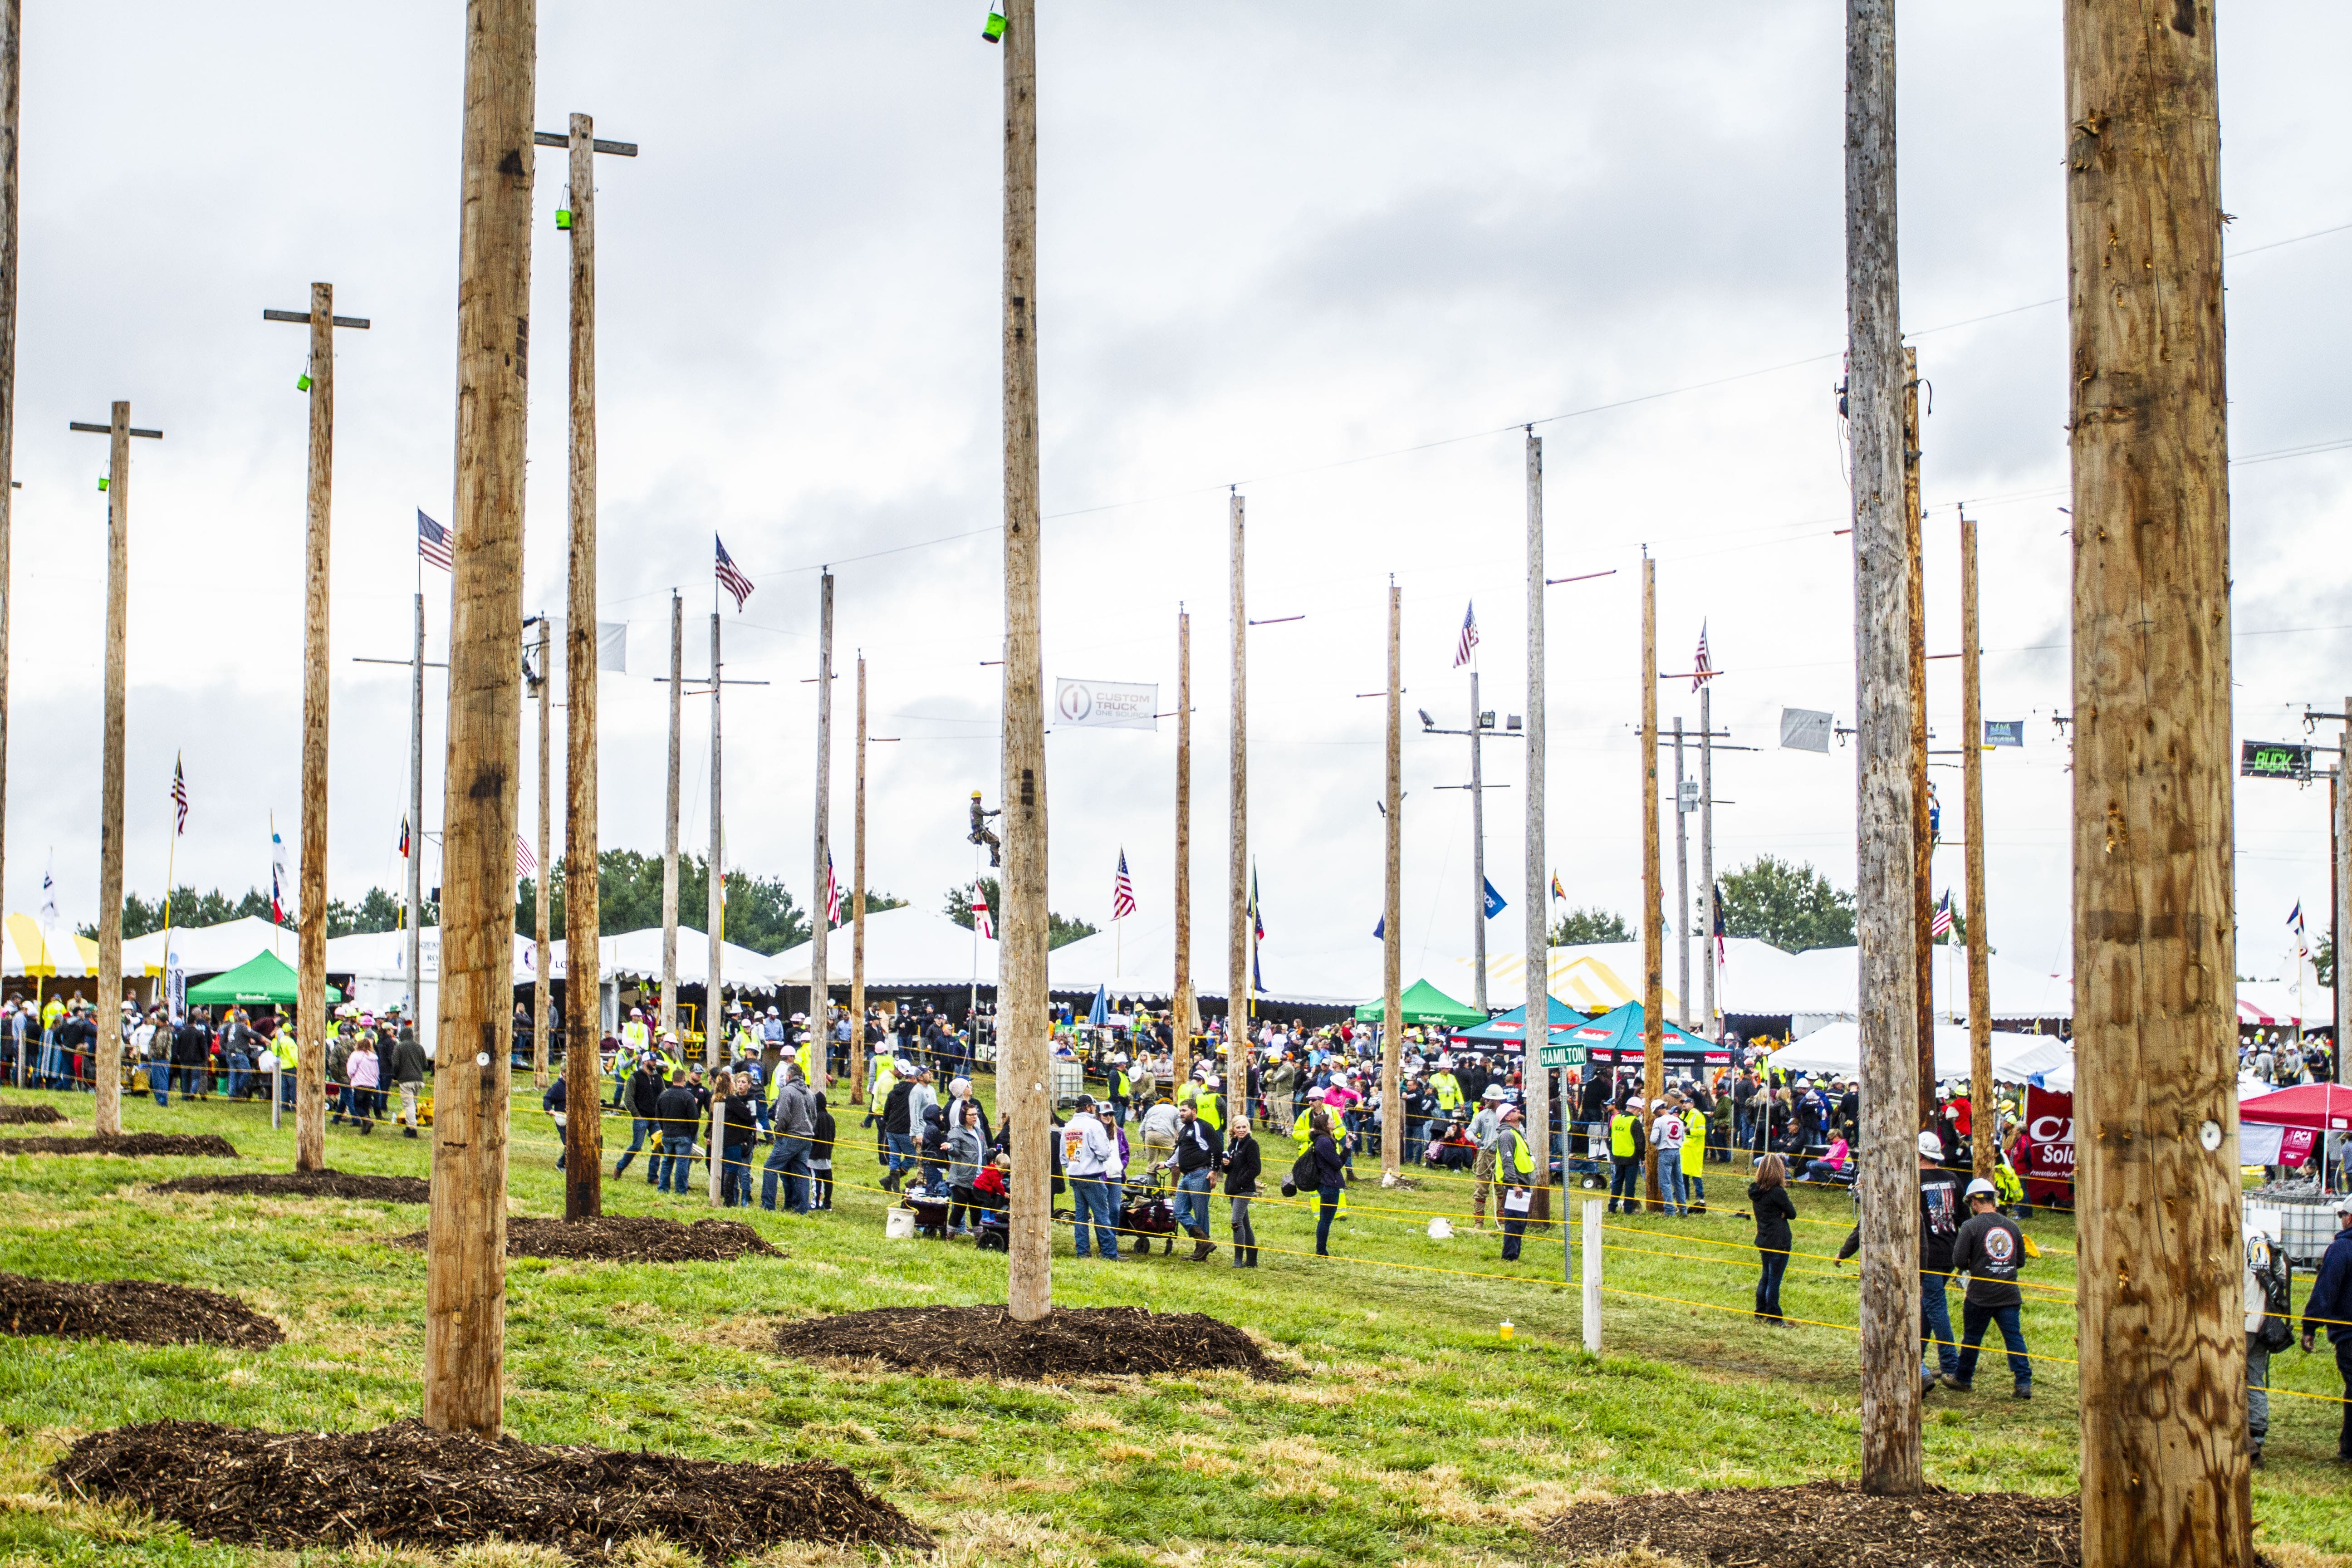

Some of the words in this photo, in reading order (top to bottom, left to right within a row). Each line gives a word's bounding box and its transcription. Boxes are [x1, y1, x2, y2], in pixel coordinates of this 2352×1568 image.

[1096, 692, 1150, 703] CUSTOM
[1096, 702, 1137, 711] TRUCK
[2254, 751, 2293, 773] BUCK
[1541, 1047, 1585, 1065] HAMILTON
[2293, 1130, 2312, 1141] PCA
